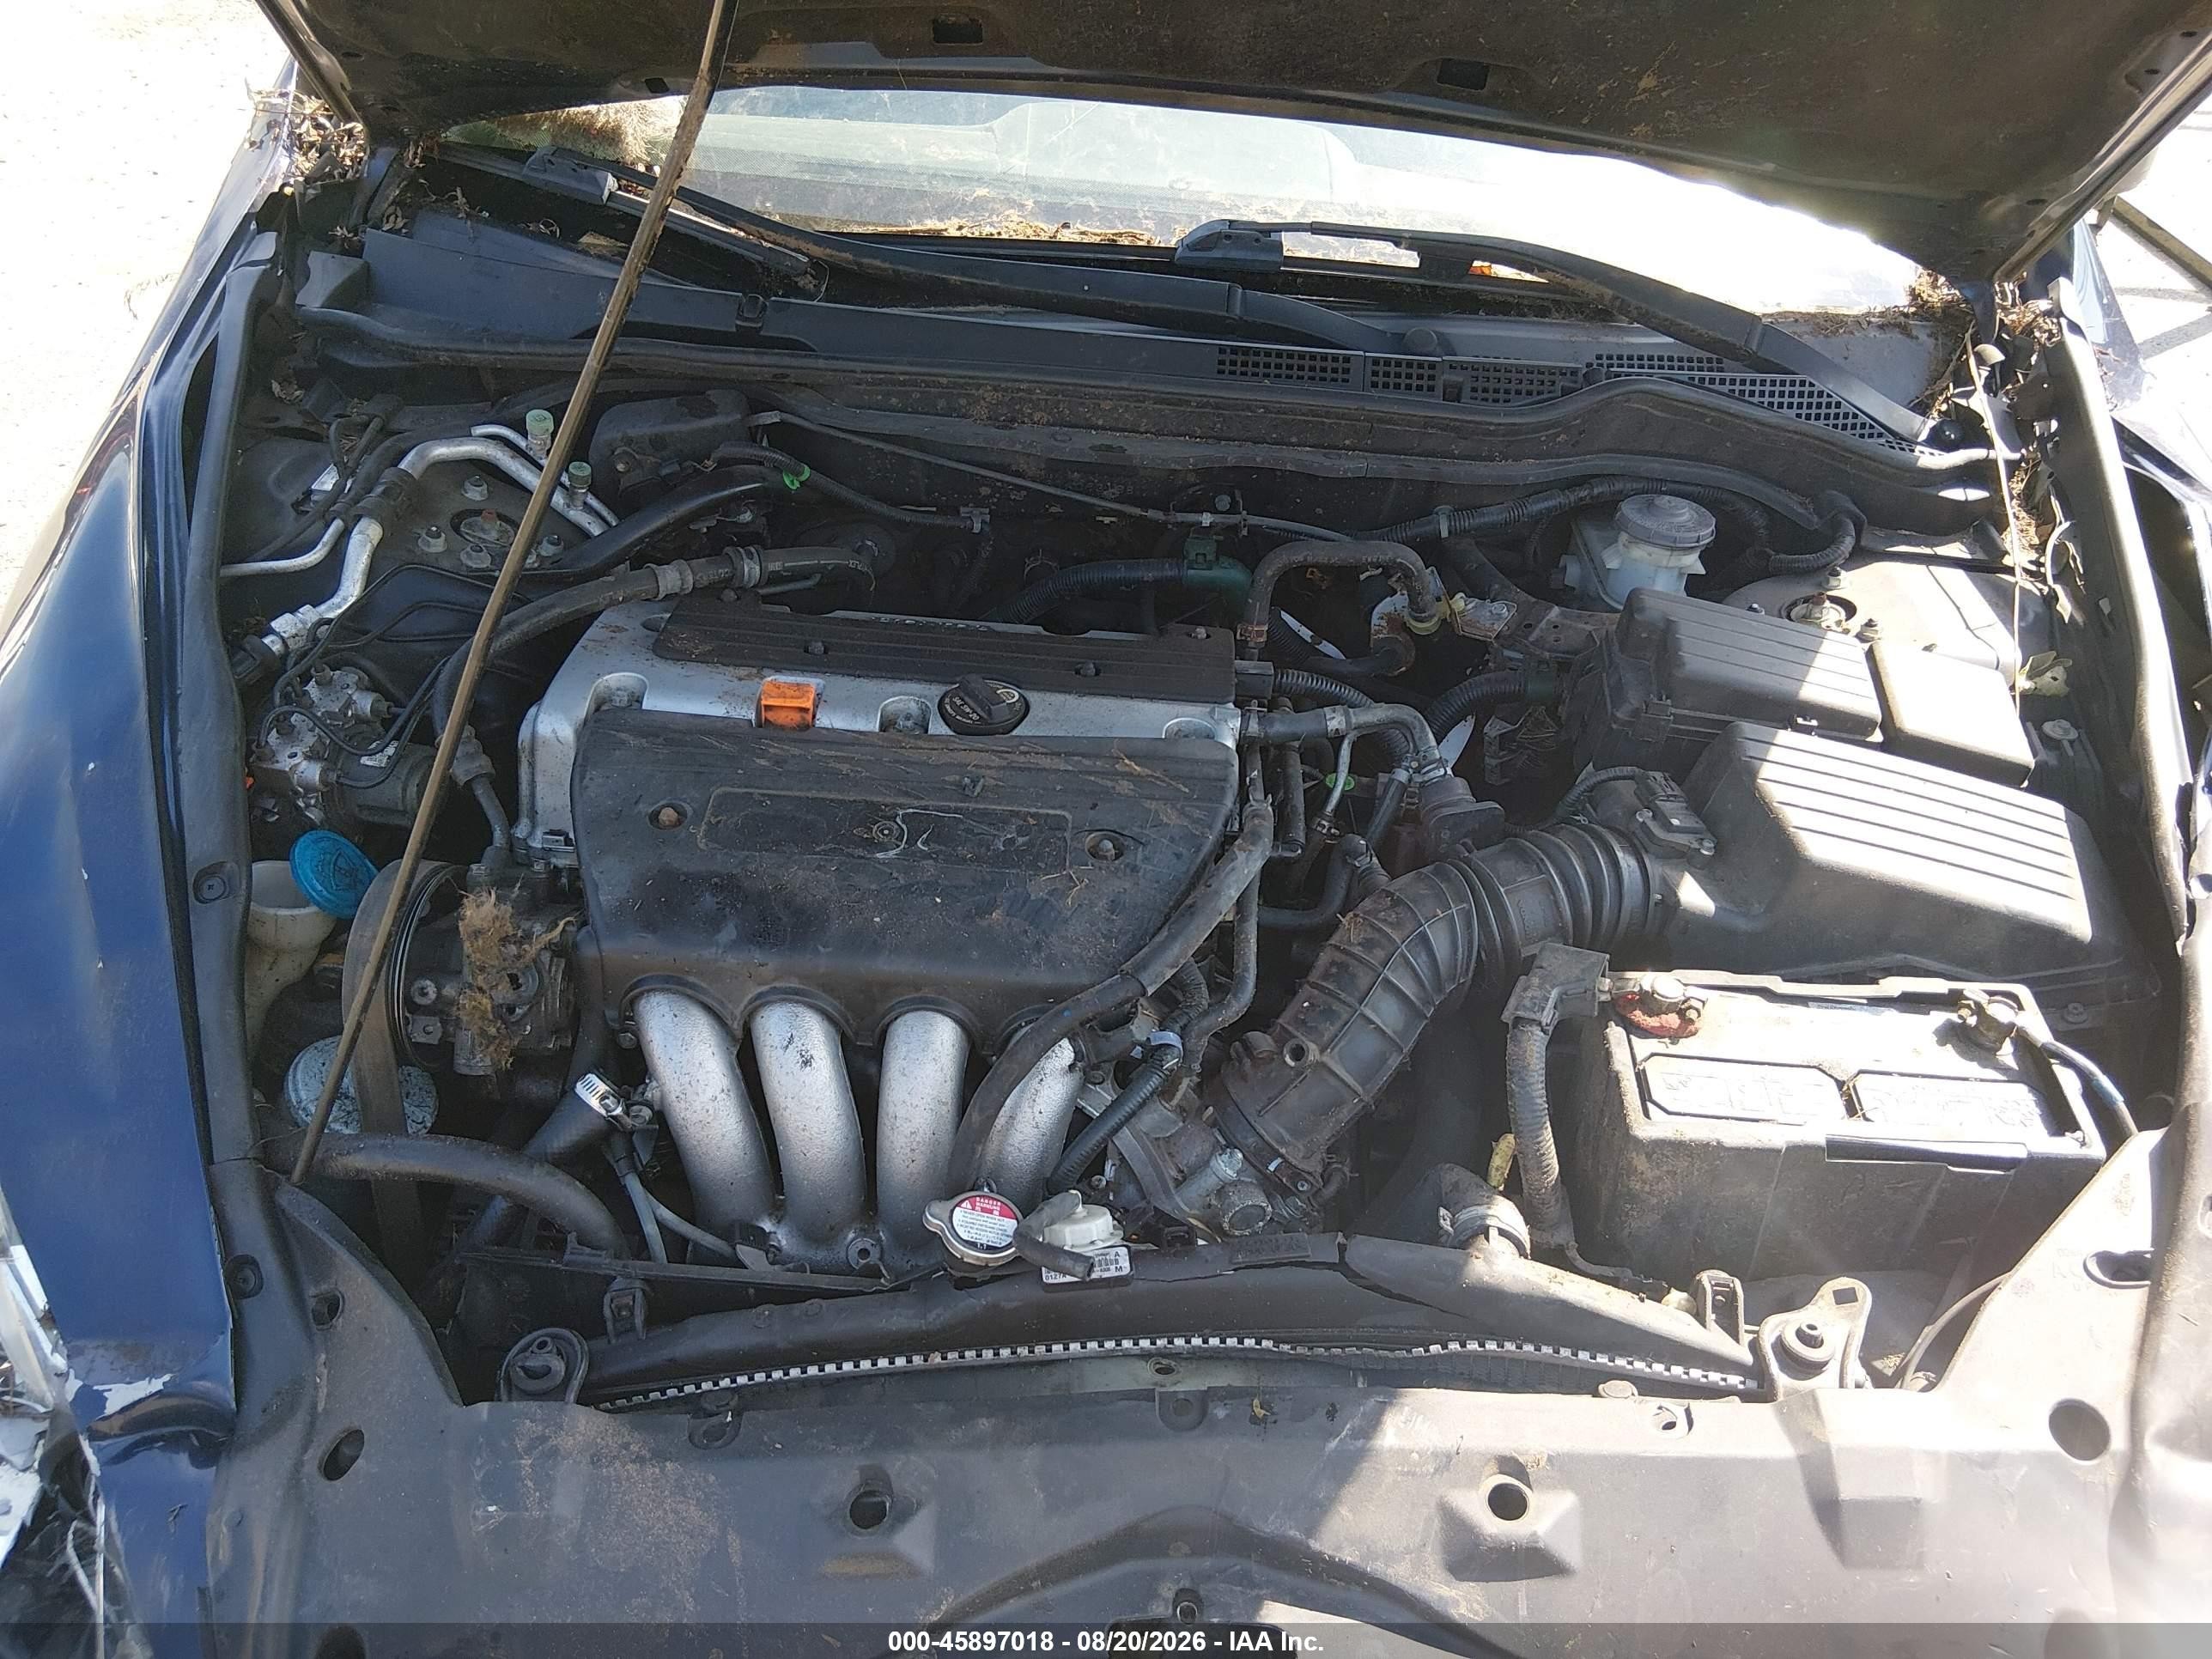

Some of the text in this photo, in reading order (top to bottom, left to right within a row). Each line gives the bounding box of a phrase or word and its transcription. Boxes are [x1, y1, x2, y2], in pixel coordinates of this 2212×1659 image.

[952, 696, 965, 706] SAE
[960, 704, 980, 720] 5W-20
[975, 1196, 1001, 1206] DANGER
